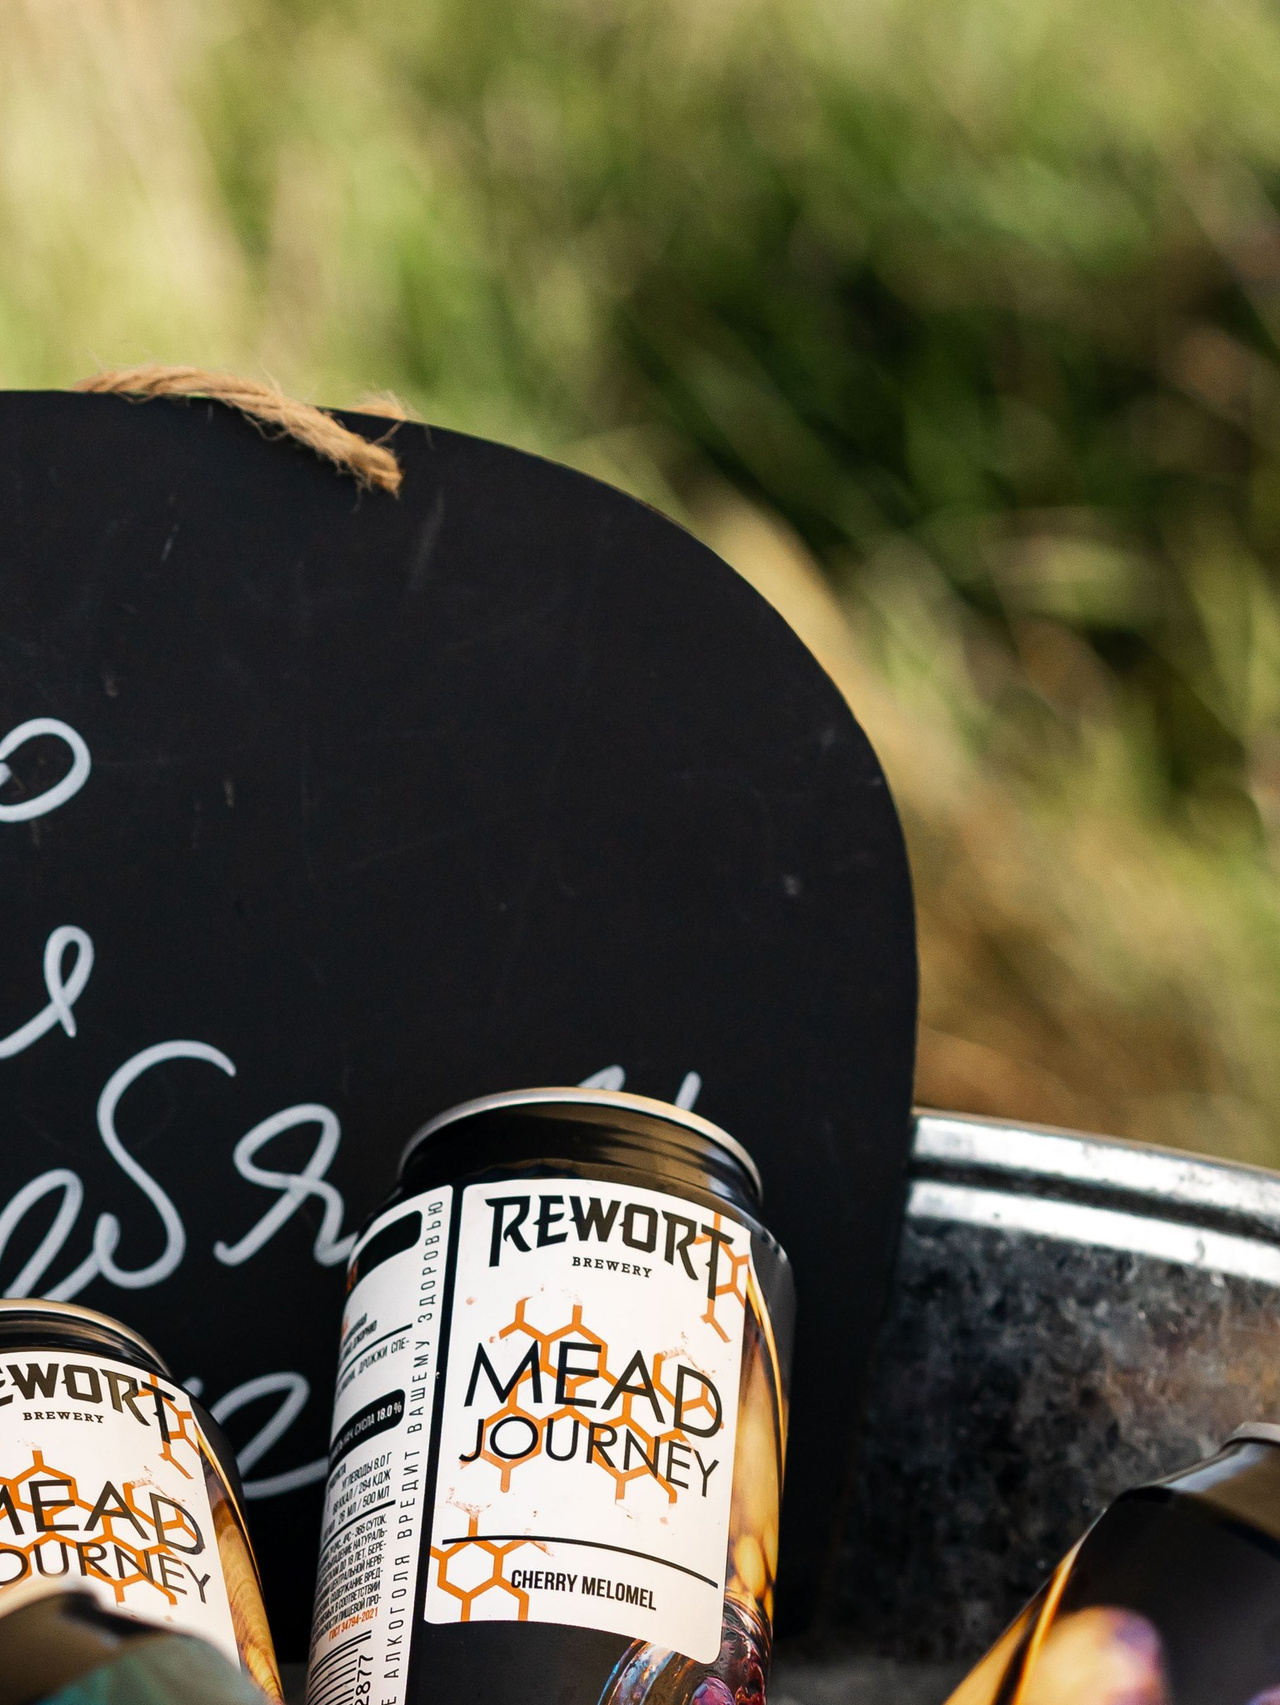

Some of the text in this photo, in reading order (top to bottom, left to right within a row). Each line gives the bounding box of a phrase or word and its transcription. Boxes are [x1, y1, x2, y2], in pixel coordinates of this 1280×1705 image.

[417, 1201, 444, 1324] ЗДОРОВЬЮ
[484, 1194, 735, 1301] REWORT
[571, 1256, 652, 1278] BREWERY
[22, 1411, 105, 1424] BREWERY
[376, 1403, 393, 1423] 18.0
[407, 1340, 431, 1434] ВАШЕМУ
[463, 1340, 723, 1438] MEAD
[397, 1450, 420, 1540] ВРЕДИТ
[458, 1416, 720, 1498] JOURNEY
[383, 1555, 410, 1679] АЛКОГОЛЯ
[510, 1569, 657, 1611] CHERRY MELOMEL
